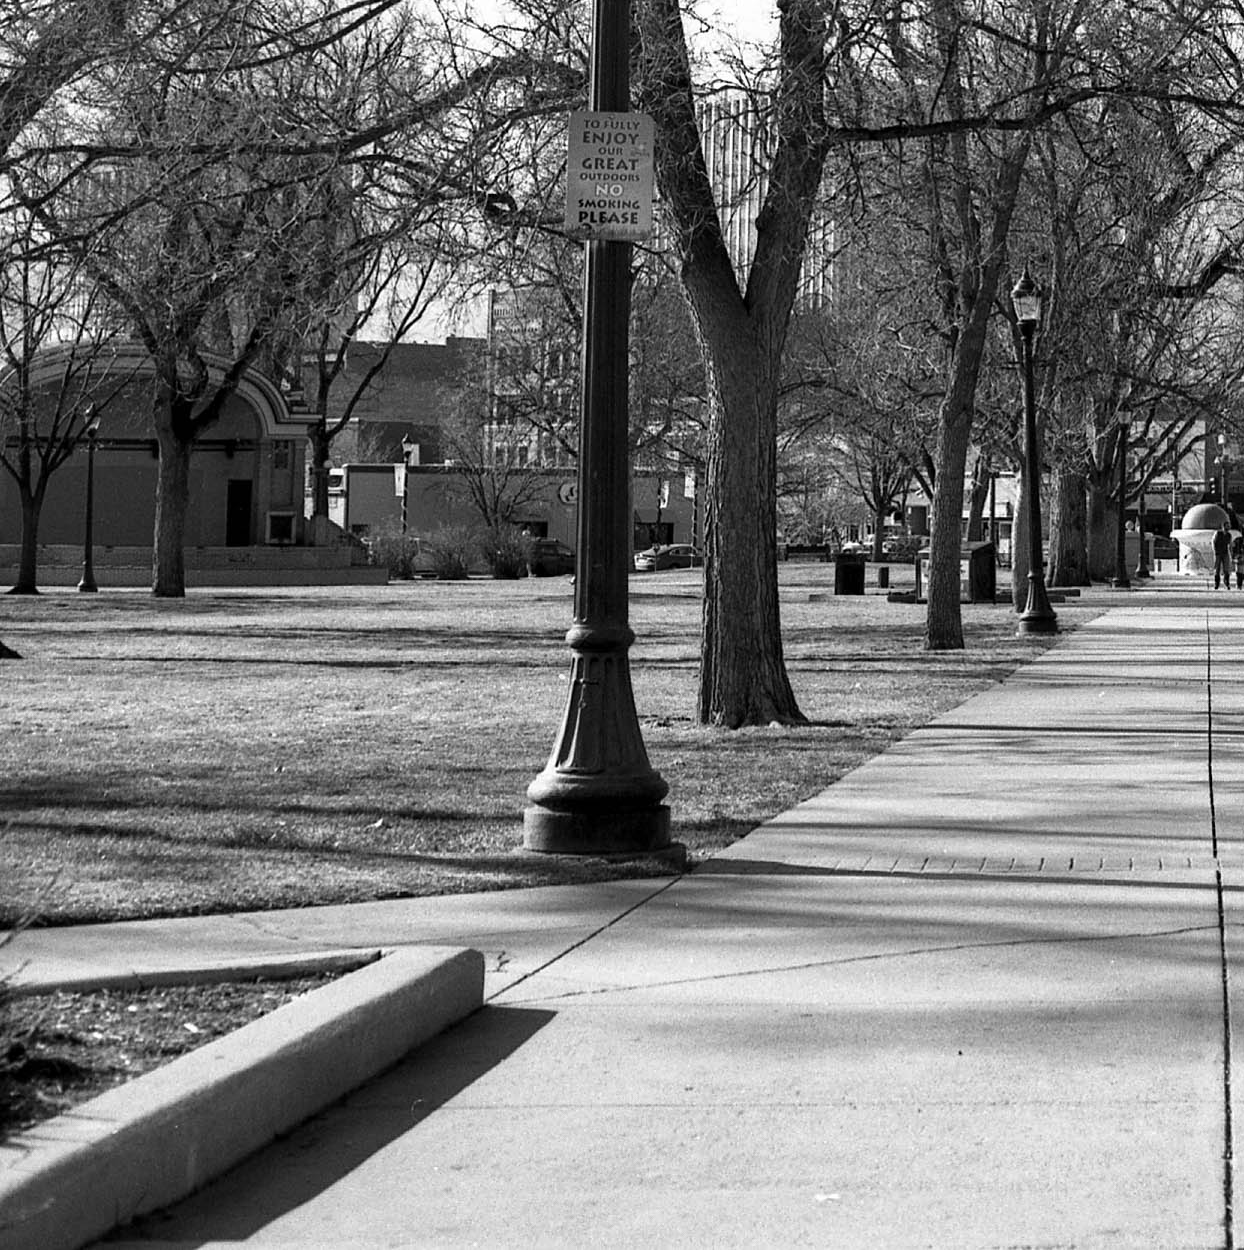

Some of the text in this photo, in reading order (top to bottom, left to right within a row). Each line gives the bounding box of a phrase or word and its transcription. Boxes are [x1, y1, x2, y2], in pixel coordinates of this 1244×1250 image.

[583, 119, 640, 130] TO FULLY
[583, 131, 640, 145] ENJOY
[598, 147, 623, 156] OUR
[582, 157, 639, 171] GREAT
[580, 172, 640, 181] OUTDOORS
[595, 183, 623, 197] NO
[578, 199, 640, 209] SMOKING
[578, 211, 639, 224] PLEASE
